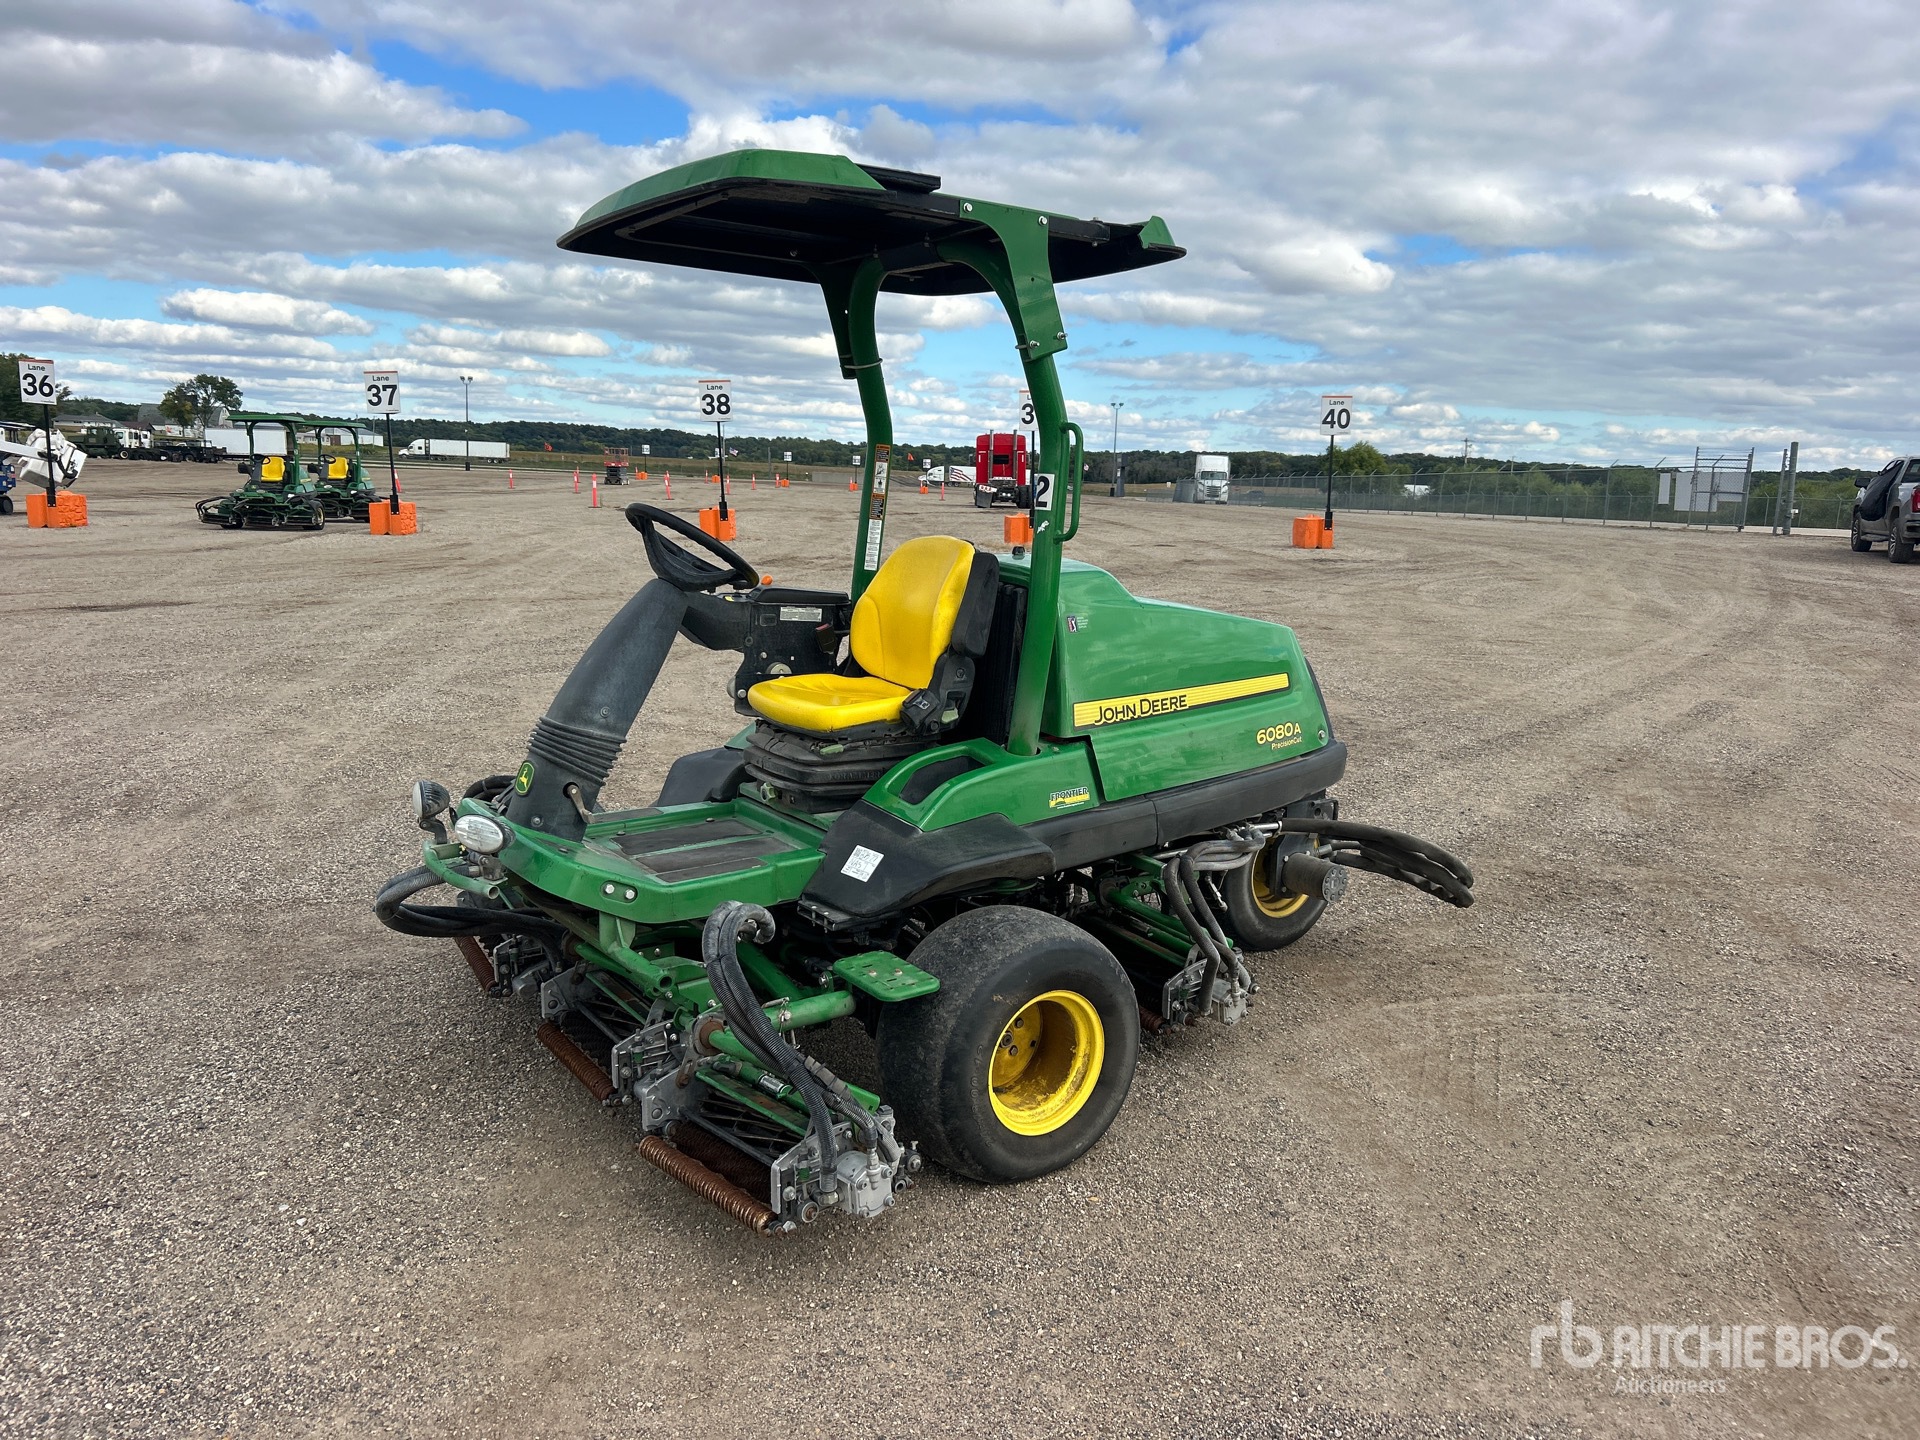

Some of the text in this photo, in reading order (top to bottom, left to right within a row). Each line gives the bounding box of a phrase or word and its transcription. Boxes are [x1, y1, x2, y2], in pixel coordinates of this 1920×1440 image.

[27, 363, 46, 371] Lane
[22, 373, 54, 397] 36
[367, 384, 398, 406] 37
[701, 393, 731, 415] 38
[1021, 403, 1035, 425] 3
[1321, 408, 1351, 429] 40
[1035, 475, 1050, 508] 2
[1094, 694, 1188, 723] JOHN DEERE
[1256, 722, 1302, 745] 6080A
[1271, 736, 1303, 750] PrecisionCut
[1050, 787, 1088, 801] FRONTIER
